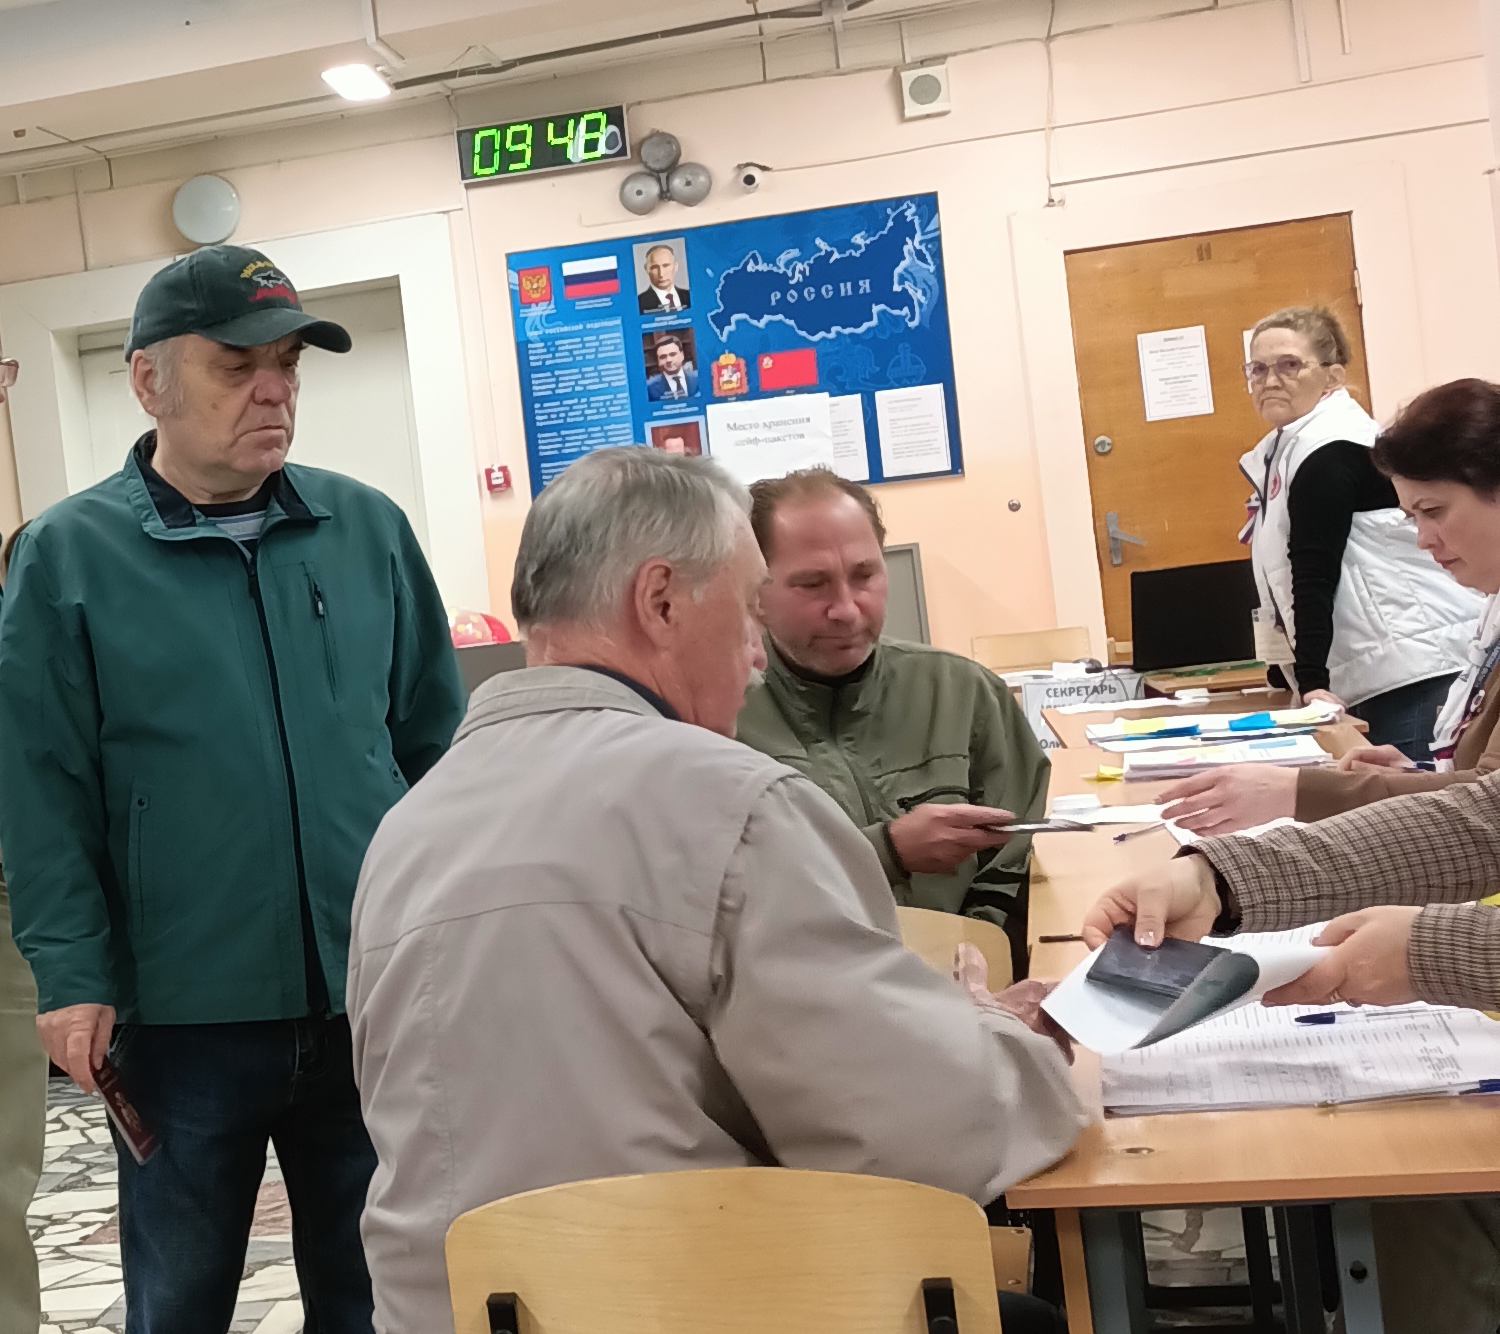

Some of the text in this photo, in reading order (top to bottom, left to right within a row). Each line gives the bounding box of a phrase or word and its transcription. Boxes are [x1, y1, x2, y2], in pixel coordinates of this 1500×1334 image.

[770, 278, 871, 306] РОССИЯ
[726, 416, 811, 432] Место хранения
[1046, 684, 1116, 698] СЕКРЕТАРЬ
